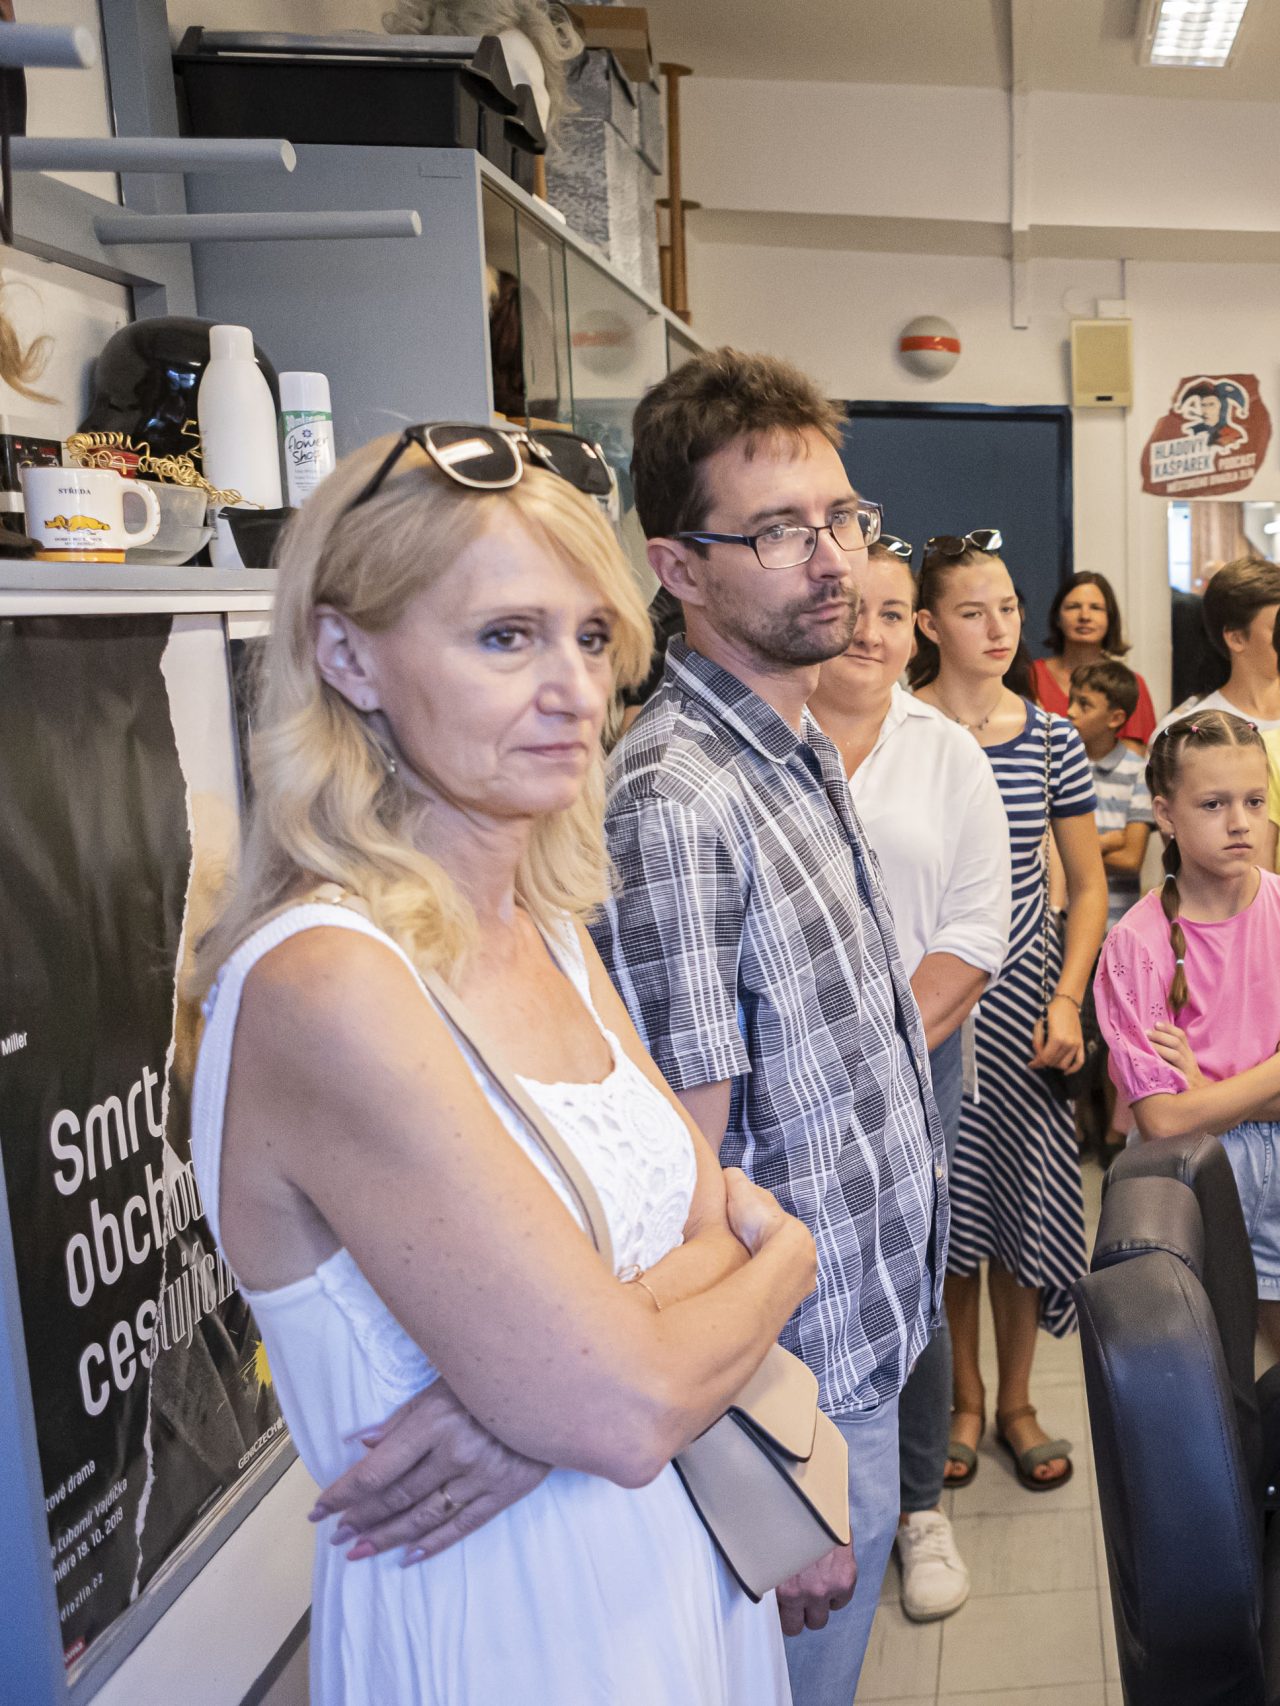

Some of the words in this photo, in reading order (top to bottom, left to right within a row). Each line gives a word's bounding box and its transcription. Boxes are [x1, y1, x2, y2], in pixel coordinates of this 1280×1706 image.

[1, 1031, 28, 1056] Miller
[50, 1065, 164, 1196] Smrt
[67, 1460, 96, 1493] drama
[90, 1528, 104, 1547] 10.
[104, 1506, 123, 1535] 2019
